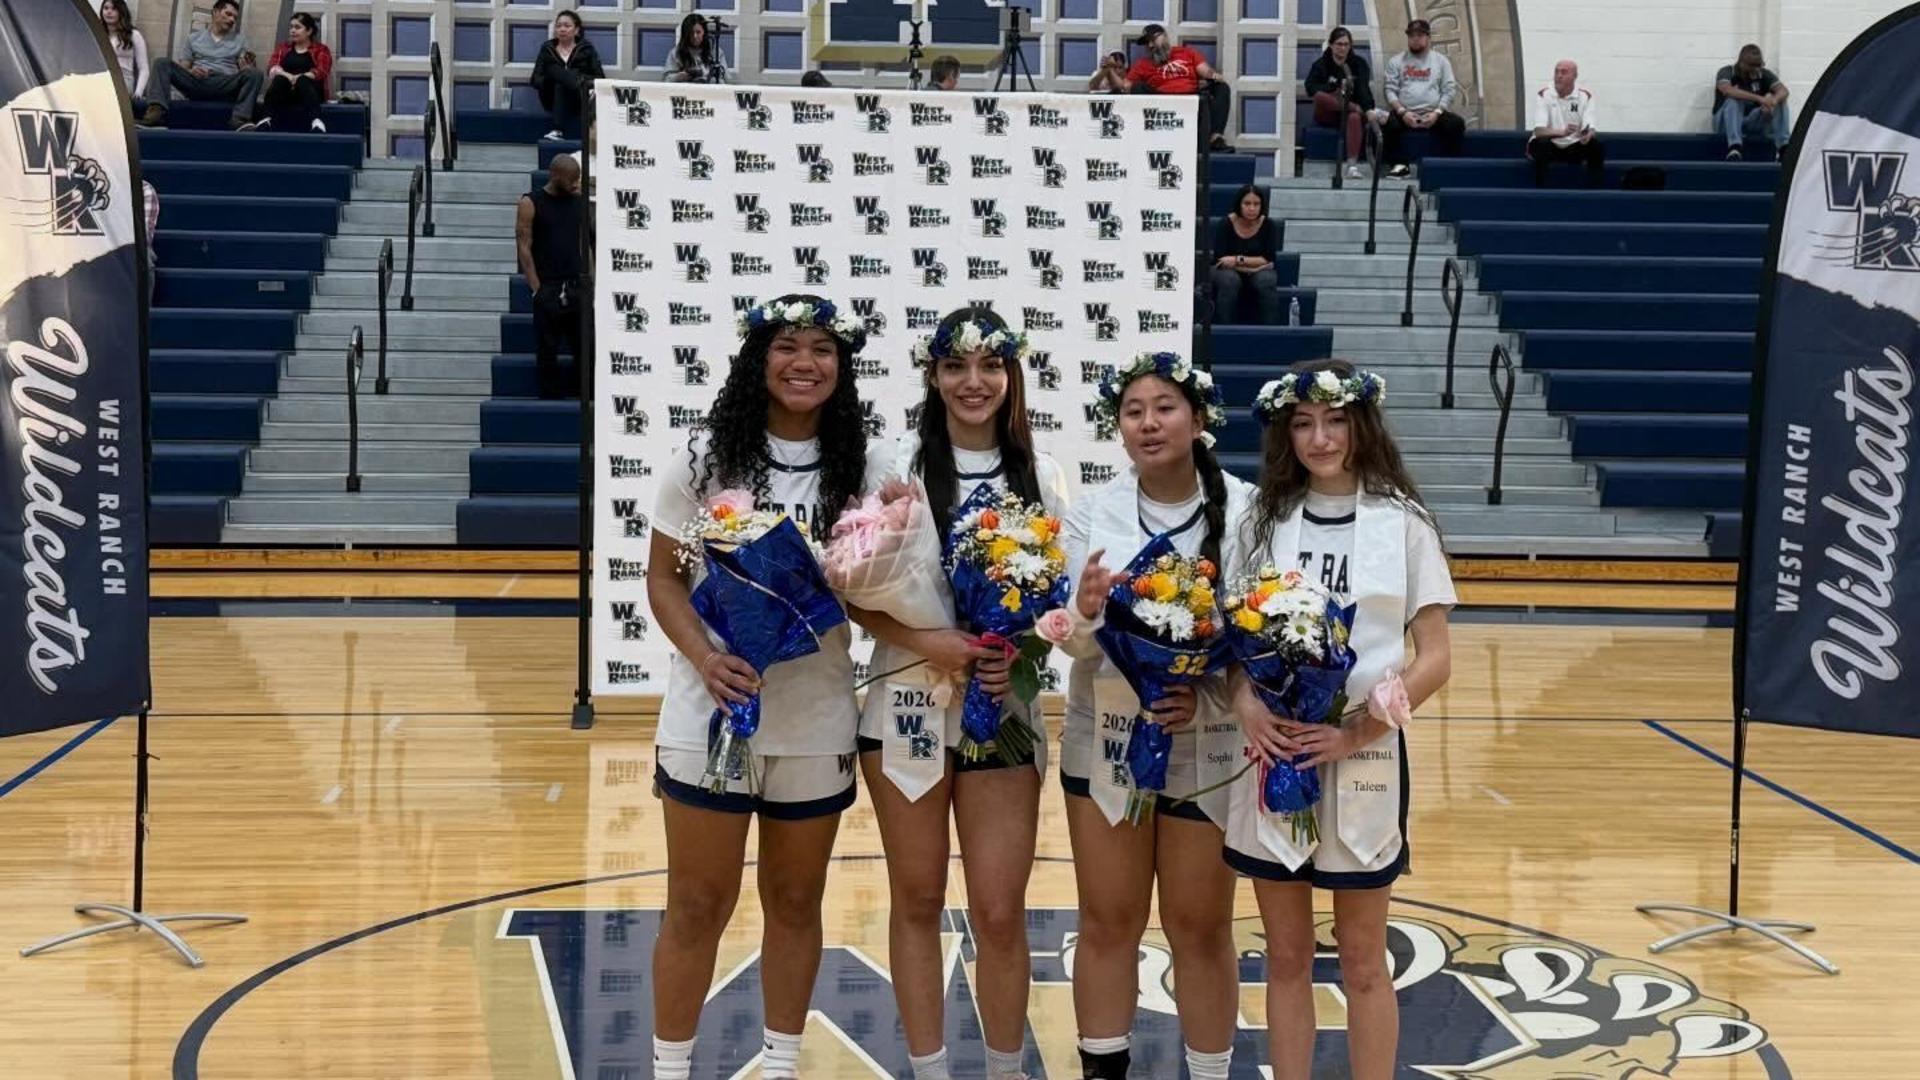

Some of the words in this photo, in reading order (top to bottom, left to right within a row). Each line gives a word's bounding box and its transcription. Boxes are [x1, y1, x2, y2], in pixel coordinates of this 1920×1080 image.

[670, 96, 705, 109] WEST
[790, 101, 825, 114] WEST
[673, 107, 714, 119] RANCH
[910, 103, 944, 116] WEST
[1028, 104, 1060, 117] WEST
[1142, 109, 1176, 121] WEST
[793, 112, 834, 123] RANCH
[912, 114, 952, 125] RANCH
[1030, 115, 1068, 127] RANCH
[1145, 119, 1184, 130] RANCH
[612, 145, 647, 158] WEST
[734, 150, 767, 163] WEST
[615, 156, 656, 168] RANCH
[852, 153, 886, 166] WEST
[970, 156, 1004, 169] WEST
[1086, 159, 1119, 171] WEST
[736, 161, 774, 172] RANCH
[855, 164, 894, 175] RANCH
[973, 167, 1012, 178] RANCH
[1088, 169, 1126, 180] RANCH
[672, 200, 706, 213] WEST
[790, 204, 824, 217] WEST
[908, 206, 942, 218] WEST
[1026, 206, 1058, 219] WEST
[674, 211, 714, 222] RANCH
[792, 215, 832, 226] RANCH
[911, 216, 950, 227] RANCH
[1140, 210, 1174, 222] WEST
[1028, 217, 1066, 229] RANCH
[1143, 220, 1182, 231] RANCH
[610, 249, 645, 262] WEST
[730, 253, 764, 266] WEST
[850, 255, 883, 268] WEST
[613, 260, 652, 271] RANCH
[733, 264, 772, 275] RANCH
[968, 258, 1000, 270] WEST
[1082, 261, 1116, 273] WEST
[852, 266, 890, 277] RANCH
[970, 268, 1008, 279] RANCH
[1085, 271, 1124, 282] RANCH
[668, 303, 703, 315] WEST
[906, 307, 939, 319] WEST
[1022, 307, 1056, 320] WEST
[671, 313, 710, 324] RANCH
[1138, 311, 1171, 323] WEST
[1025, 318, 1064, 330] RANCH
[1140, 321, 1178, 332] RANCH
[610, 352, 644, 365] WEST
[612, 363, 652, 374] RANCH
[668, 405, 702, 418] WEST
[97, 399, 119, 476] WEST
[610, 455, 644, 468] WEST
[612, 466, 652, 478] RANCH
[1079, 462, 1113, 474] WEST
[1782, 424, 1811, 525] RANCH
[7, 316, 91, 694] Wildcats
[1810, 345, 1915, 700] Wildcats
[97, 492, 127, 595] RANCH
[608, 558, 641, 570] WEST
[1775, 538, 1803, 612] WEST
[608, 661, 642, 674] WEST
[1168, 654, 1208, 676] 32
[610, 672, 650, 683] RANCH
[1353, 780, 1387, 792] Taleen
